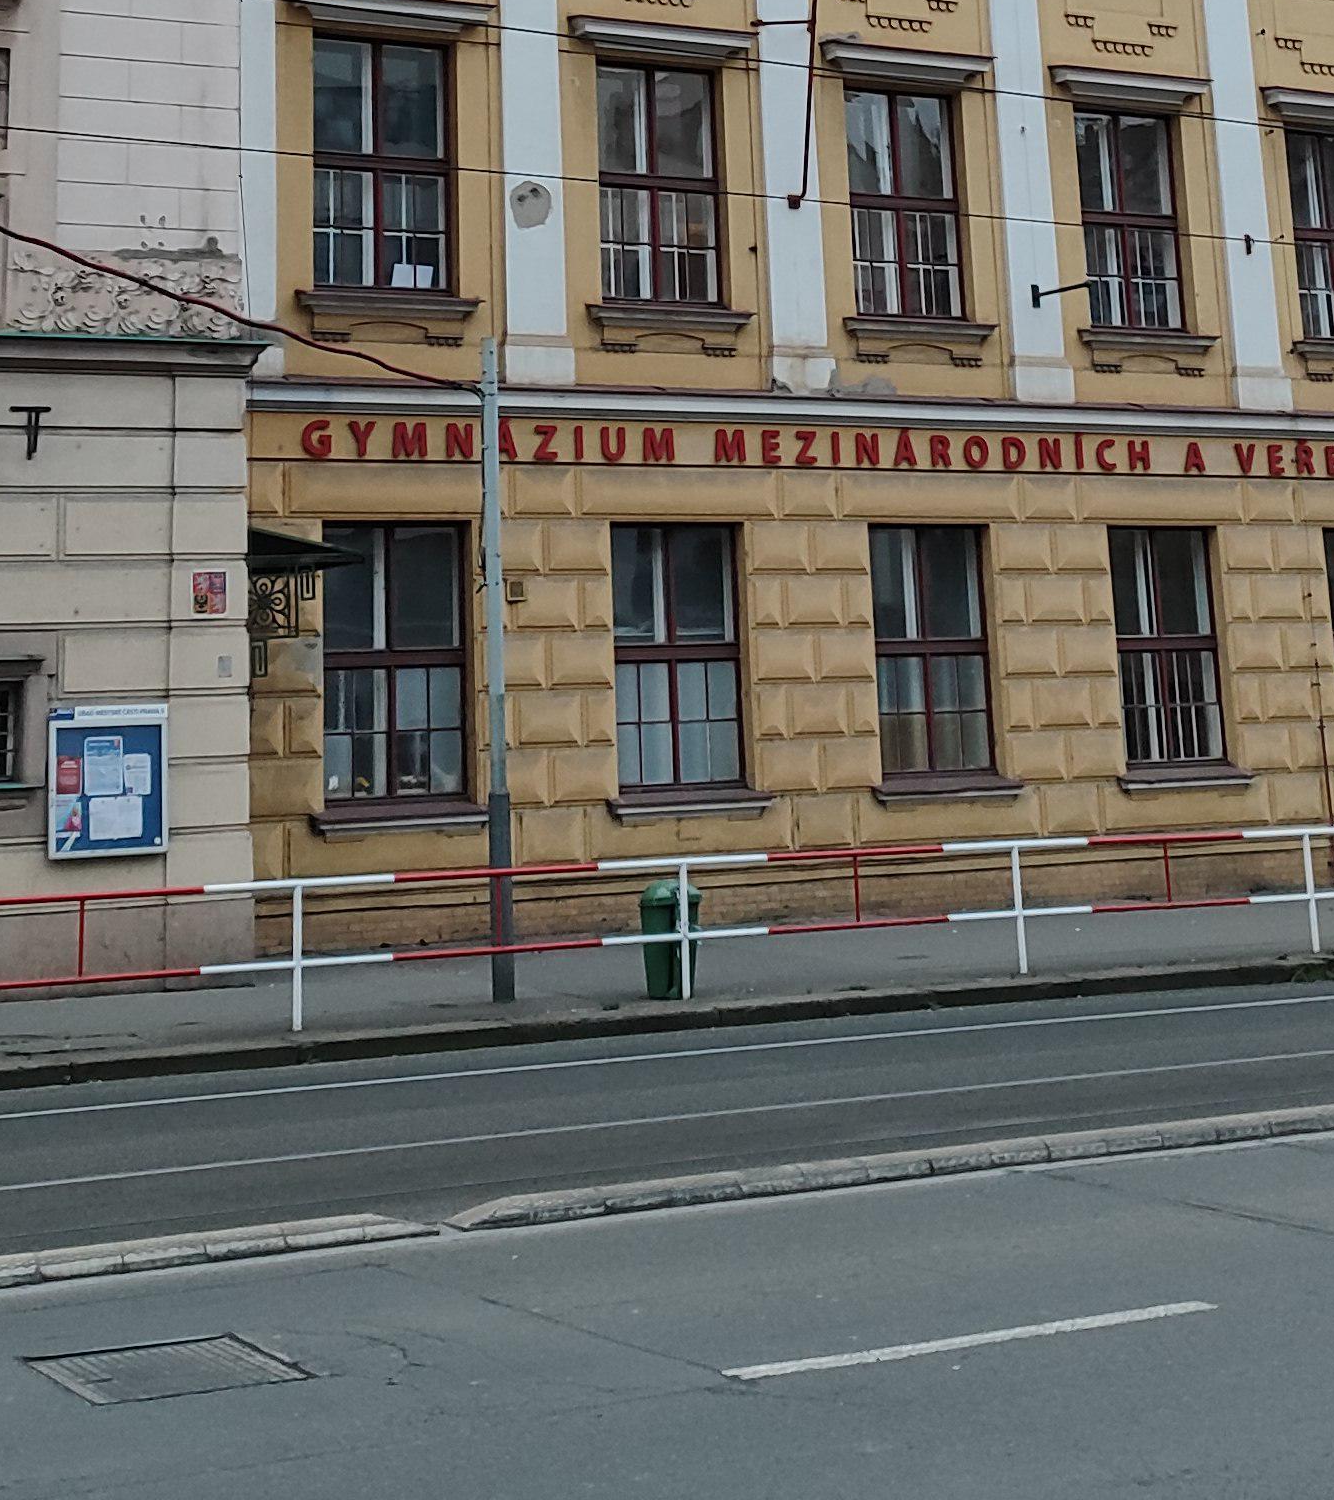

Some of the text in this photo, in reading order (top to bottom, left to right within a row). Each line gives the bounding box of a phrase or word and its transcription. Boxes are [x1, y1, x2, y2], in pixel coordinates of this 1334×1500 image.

[301, 417, 675, 462] GYMNÁZIUM
[714, 428, 1151, 471] MEZINÁRODNÍCH
[1184, 441, 1206, 474] A
